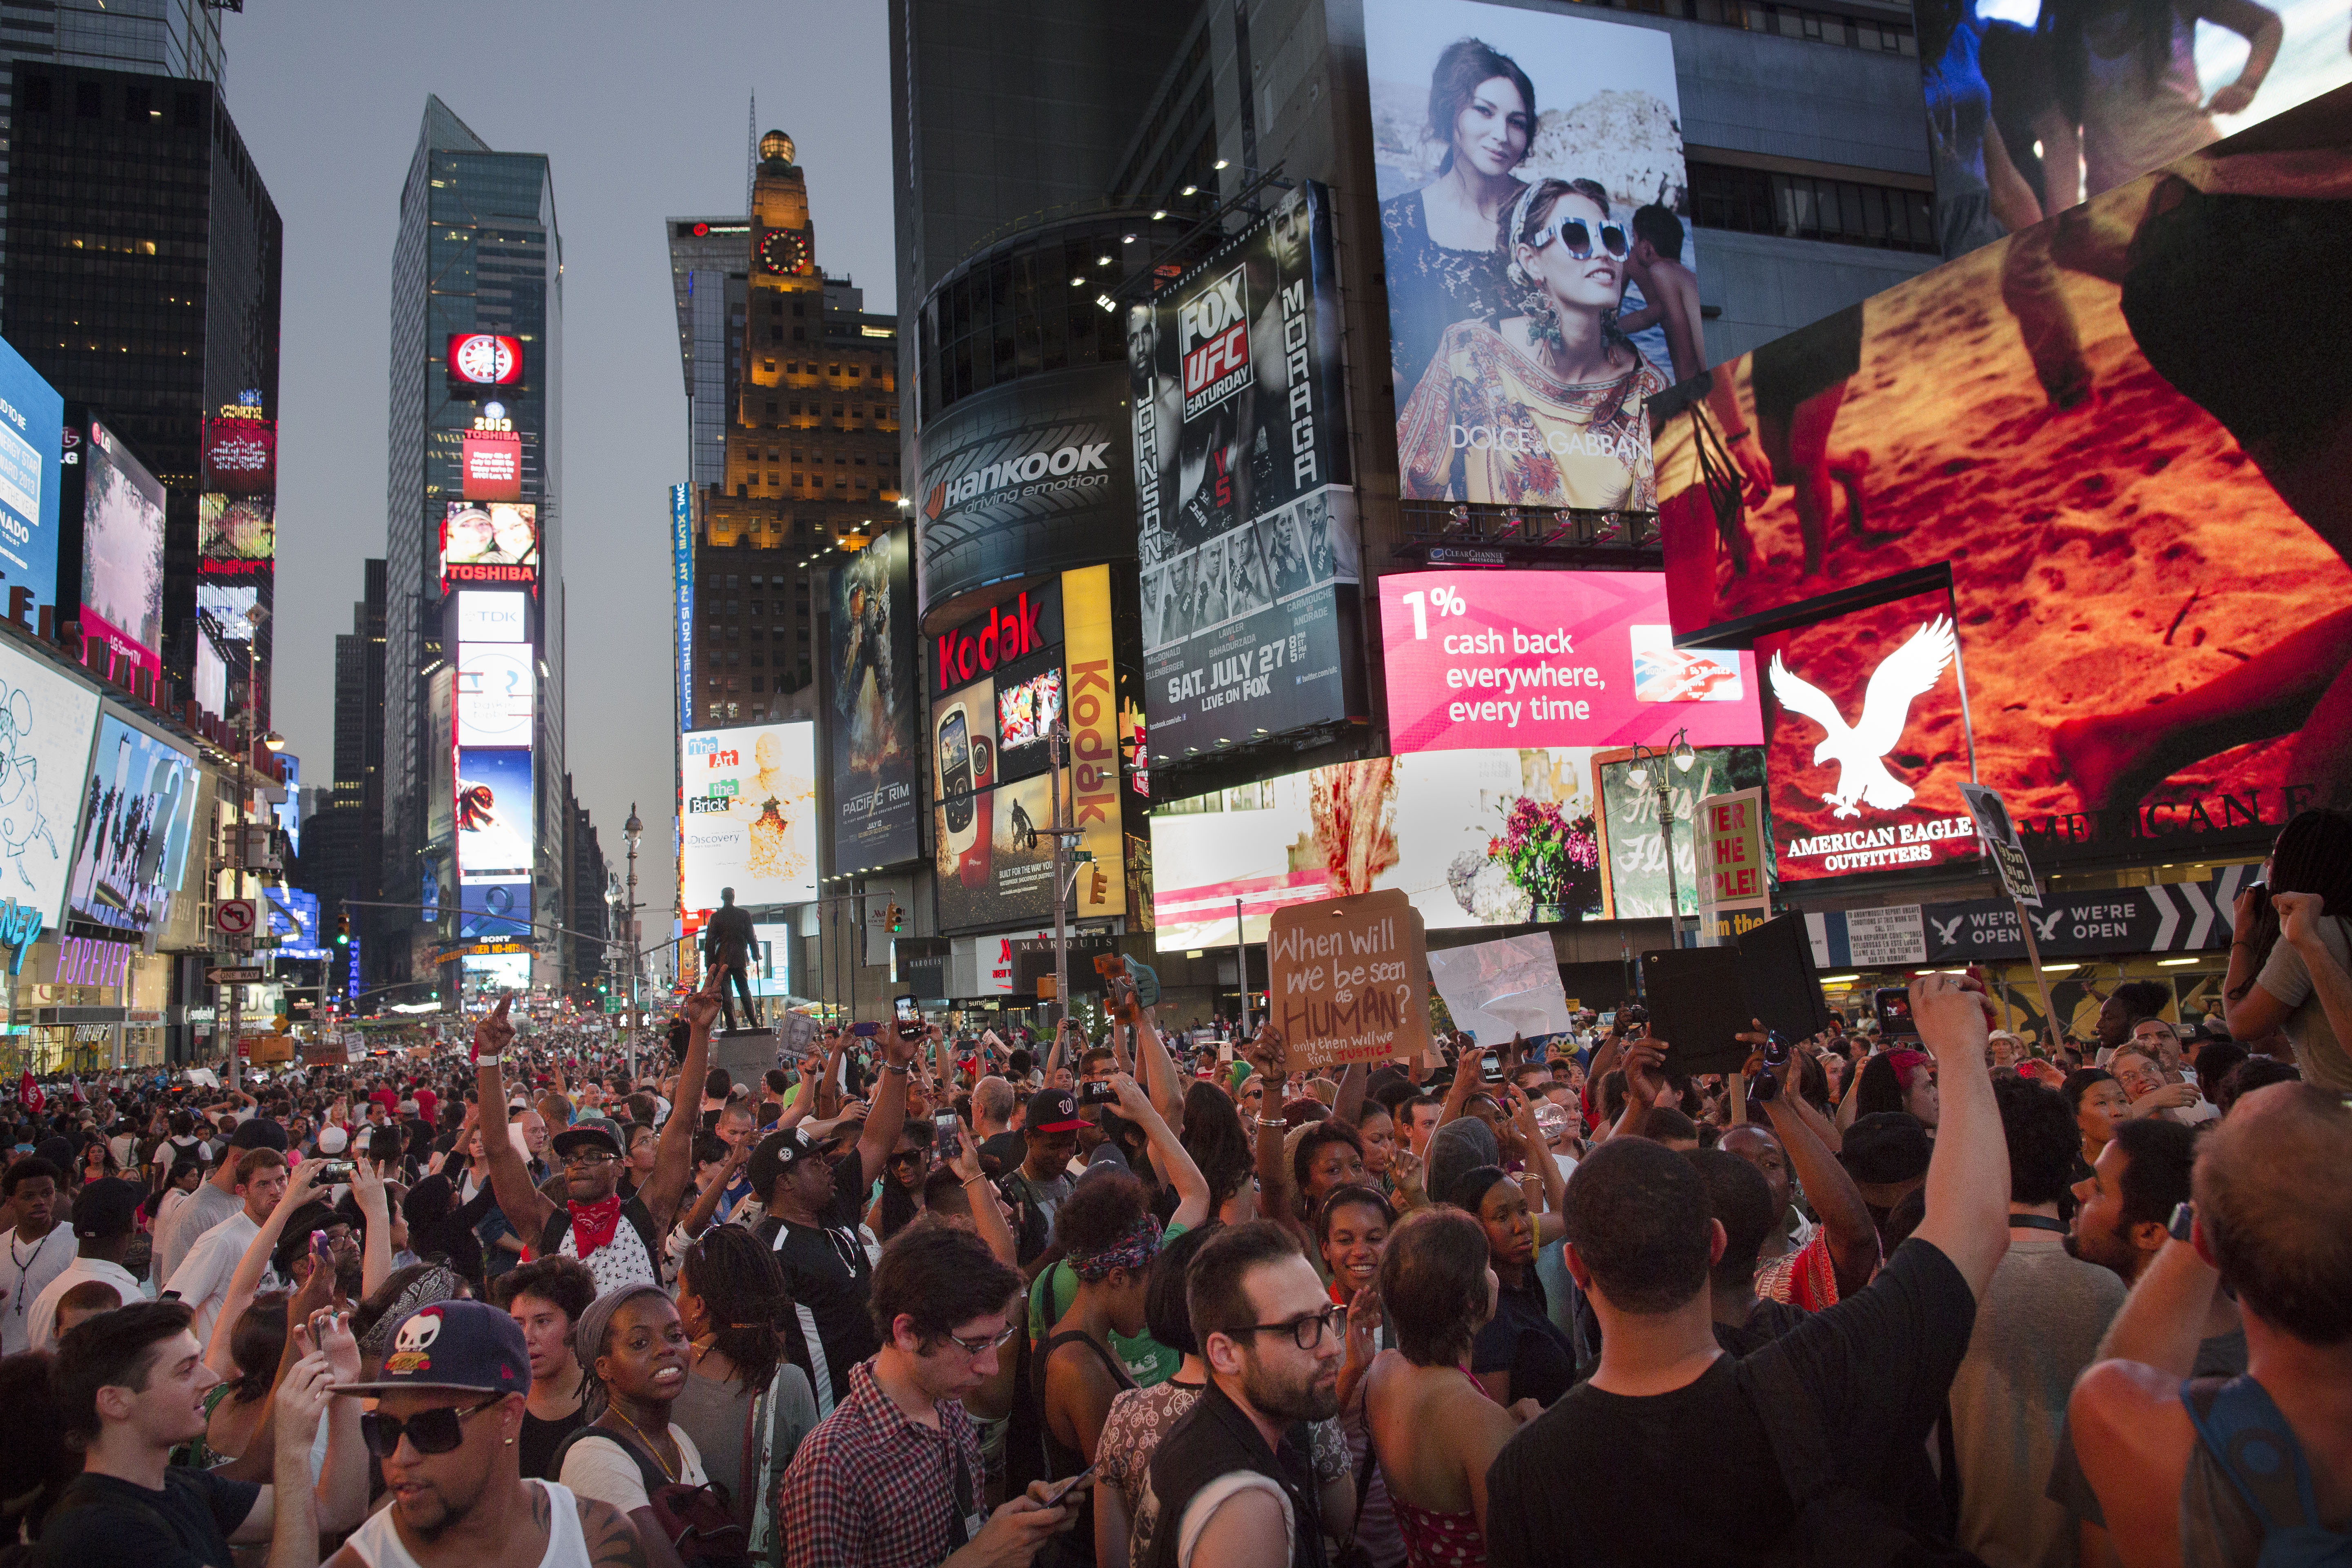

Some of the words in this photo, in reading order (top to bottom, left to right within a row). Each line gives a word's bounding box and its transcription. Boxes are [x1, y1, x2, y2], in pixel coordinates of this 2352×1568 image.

[1164, 256, 1213, 297] FLYWEIGHT
[1184, 272, 1245, 355] FOX
[1186, 325, 1245, 394] UFC
[1186, 365, 1249, 416] SATURDAY
[1283, 278, 1317, 490] MORAGA
[474, 417, 511, 432] 2013
[100, 432, 111, 454] LG
[464, 429, 520, 441] TOSHIBA
[1450, 425, 1530, 453] DOLCE
[1534, 440, 1545, 453] &
[1547, 431, 1653, 460] GABBAN
[21, 446, 38, 477] STAR
[1138, 377, 1162, 565] JOHNSON
[19, 470, 35, 494] 2013
[1214, 446, 1230, 508] VS
[965, 489, 1019, 514] driving
[1022, 473, 1109, 497] emotion
[678, 513, 687, 550] XLVIII
[447, 565, 534, 581] TOSHIBA
[679, 562, 688, 581] NY
[681, 585, 688, 603] NJ
[1287, 588, 1332, 612] CARMOUCHE
[477, 612, 516, 621] TDK
[682, 607, 690, 619] IS
[1294, 606, 1327, 627] ANDRADE
[682, 622, 690, 642] ON
[939, 591, 1044, 690] Kodak
[1218, 622, 1244, 639] LAWLER
[1298, 631, 1306, 640] PM
[1209, 634, 1256, 658] BAHADURZADA
[1289, 635, 1296, 649] 8
[1298, 645, 1307, 653] PM
[1444, 629, 1504, 655] cash
[1513, 627, 1574, 654] back
[1290, 648, 1297, 663] 5
[1146, 660, 1184, 680] ELLENBERGER
[1168, 669, 1205, 704] SAT.
[1210, 650, 1253, 690] JULY
[1259, 639, 1285, 673] 27
[1302, 666, 1338, 683] twitter.com/ufc
[1446, 661, 1606, 694] everywhere,
[1201, 692, 1223, 712] LIVE
[1226, 687, 1239, 703] ON
[1243, 673, 1271, 701] FOX
[947, 715, 955, 724] Kodak
[1449, 697, 1521, 728] every
[1530, 695, 1590, 720] time
[1149, 716, 1181, 731] facebook.com/ufc
[690, 741, 716, 754] The
[1070, 658, 1115, 824] Kodak
[713, 753, 734, 767] Art
[713, 782, 735, 795] the
[693, 798, 726, 813] Brick
[843, 792, 883, 816] PACIFIC
[889, 783, 909, 802] RIM
[867, 820, 877, 830] JULY
[691, 833, 739, 844] Discovery
[1788, 827, 1894, 858] AMERICAN
[1899, 817, 1973, 840] EAGLE
[1077, 853, 1084, 861] 46
[1710, 836, 1745, 866] THE
[1825, 844, 1932, 871] OUTFITTERS
[1000, 869, 1011, 878] BUILT
[1012, 868, 1020, 876] FOR
[1021, 866, 1031, 874] THE
[1031, 863, 1042, 872] WAY
[1042, 861, 1053, 870] YOU
[2071, 904, 2136, 921] WE'RE
[1734, 913, 1764, 935] the
[2073, 922, 2127, 939] OPEN
[263, 939, 272, 947] 46
[480, 935, 511, 943] SONY
[1021, 938, 1112, 950] MARQUIS
[1274, 927, 1343, 962] When
[1972, 928, 2020, 944] OPEN
[492, 943, 520, 954] NO-HITS
[55, 935, 130, 987] FOREVER
[910, 958, 942, 967] MARQUIS
[1287, 965, 1325, 994] we
[1333, 958, 1366, 989] be
[1370, 960, 1405, 983] seen
[1335, 989, 1353, 1003] as
[799, 1015, 817, 1025] ASSHOLES
[1283, 984, 1411, 1047] HUMAN?
[74, 1025, 105, 1042] FOREVER
[1293, 1039, 1316, 1054] only
[1318, 1036, 1347, 1049] then
[1376, 1031, 1394, 1042] we
[1307, 1051, 1333, 1065] find
[1336, 1042, 1392, 1061] JUSTICE
